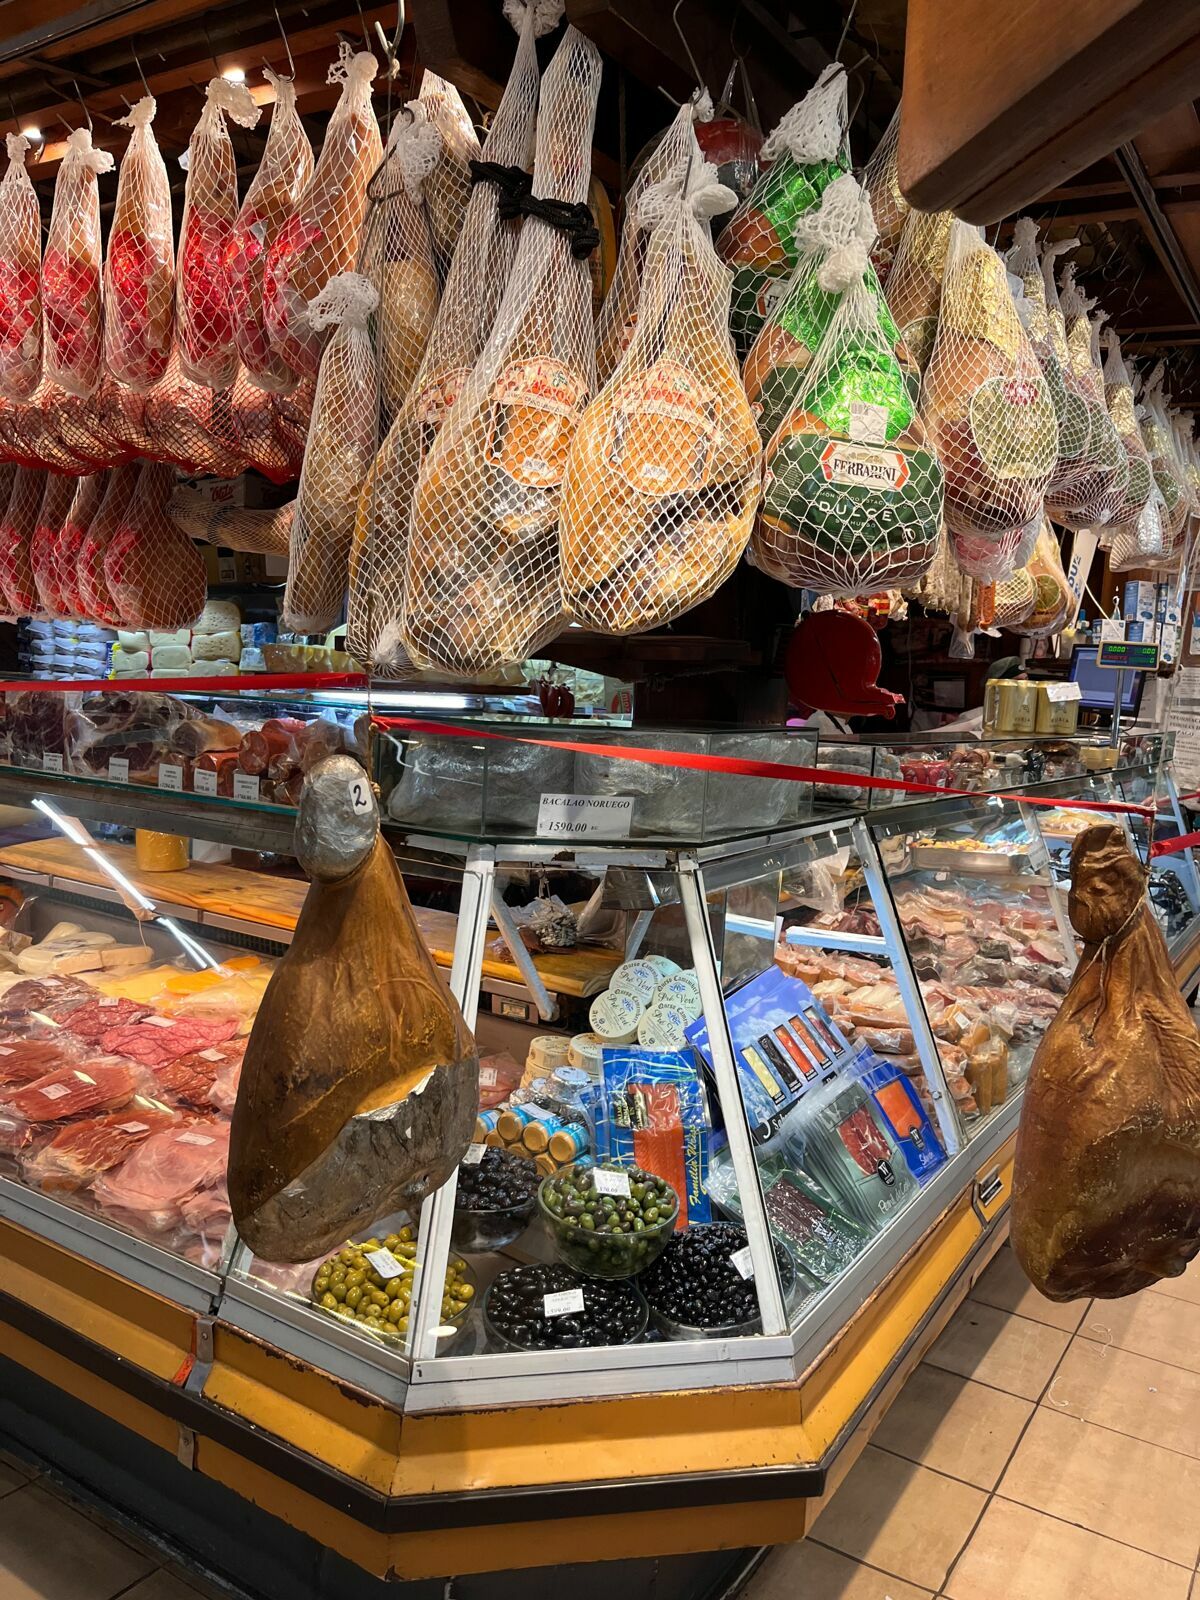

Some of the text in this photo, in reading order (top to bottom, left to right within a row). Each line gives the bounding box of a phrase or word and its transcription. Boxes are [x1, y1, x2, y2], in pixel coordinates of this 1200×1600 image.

[833, 458, 897, 482] FERRARINI
[818, 501, 893, 523] DULCE
[353, 784, 367, 807] 2
[542, 798, 630, 809] BACALAO NORUEGO
[548, 821, 588, 833] 1590.00
